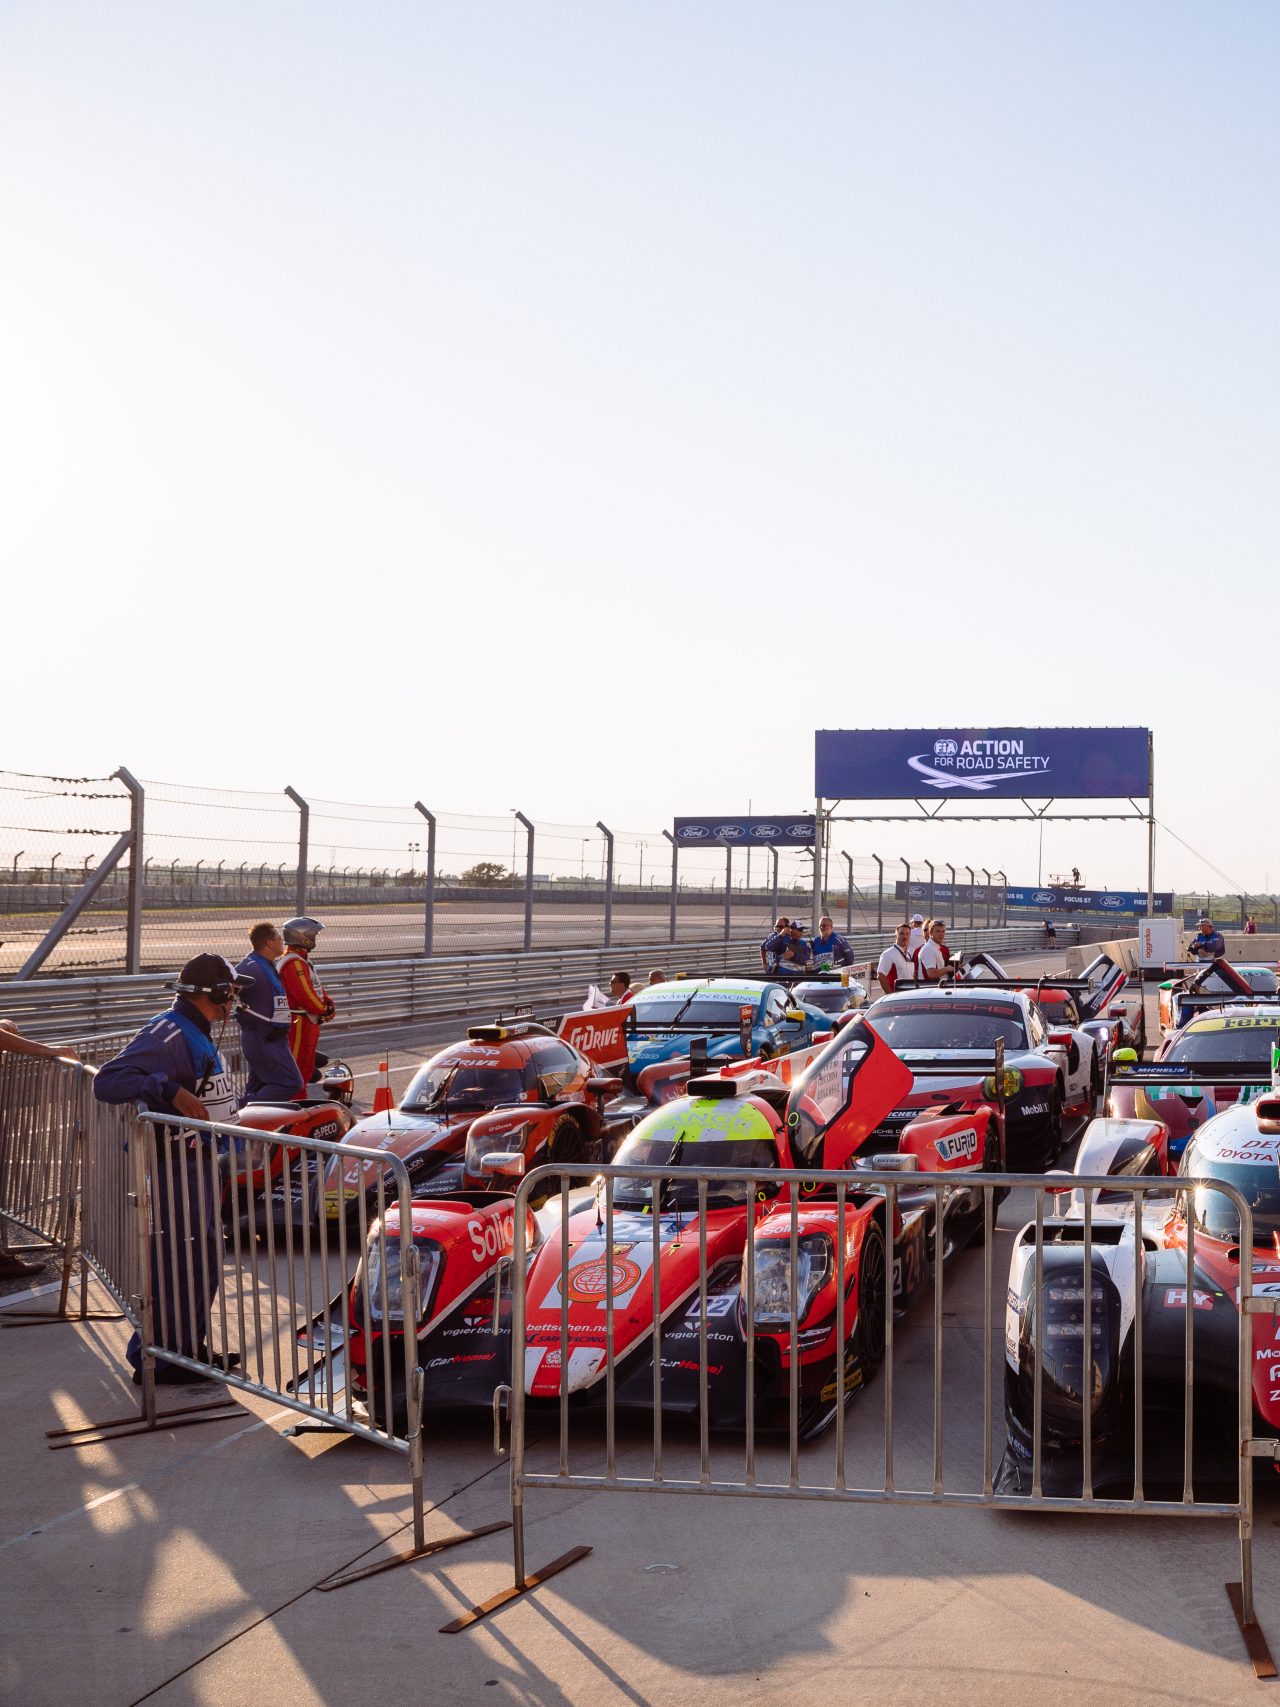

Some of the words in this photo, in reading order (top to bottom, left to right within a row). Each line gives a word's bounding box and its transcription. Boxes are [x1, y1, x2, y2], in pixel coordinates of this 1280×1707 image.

[935, 742, 957, 753] FIA
[960, 740, 1024, 755] ACTION
[934, 757, 954, 766] FOR
[957, 757, 994, 769] ROAD
[997, 756, 1050, 769] SAFETY
[712, 993, 757, 1003] RACING
[872, 1004, 1016, 1016] PORSCHE
[1021, 1104, 1043, 1116] Mobil
[320, 1122, 338, 1135] PECO
[1217, 1148, 1273, 1162] TOYOTA
[1167, 1291, 1211, 1306] HY
[442, 1327, 477, 1337] vigier
[664, 1332, 699, 1340] vigier
[706, 1332, 734, 1342] eton
